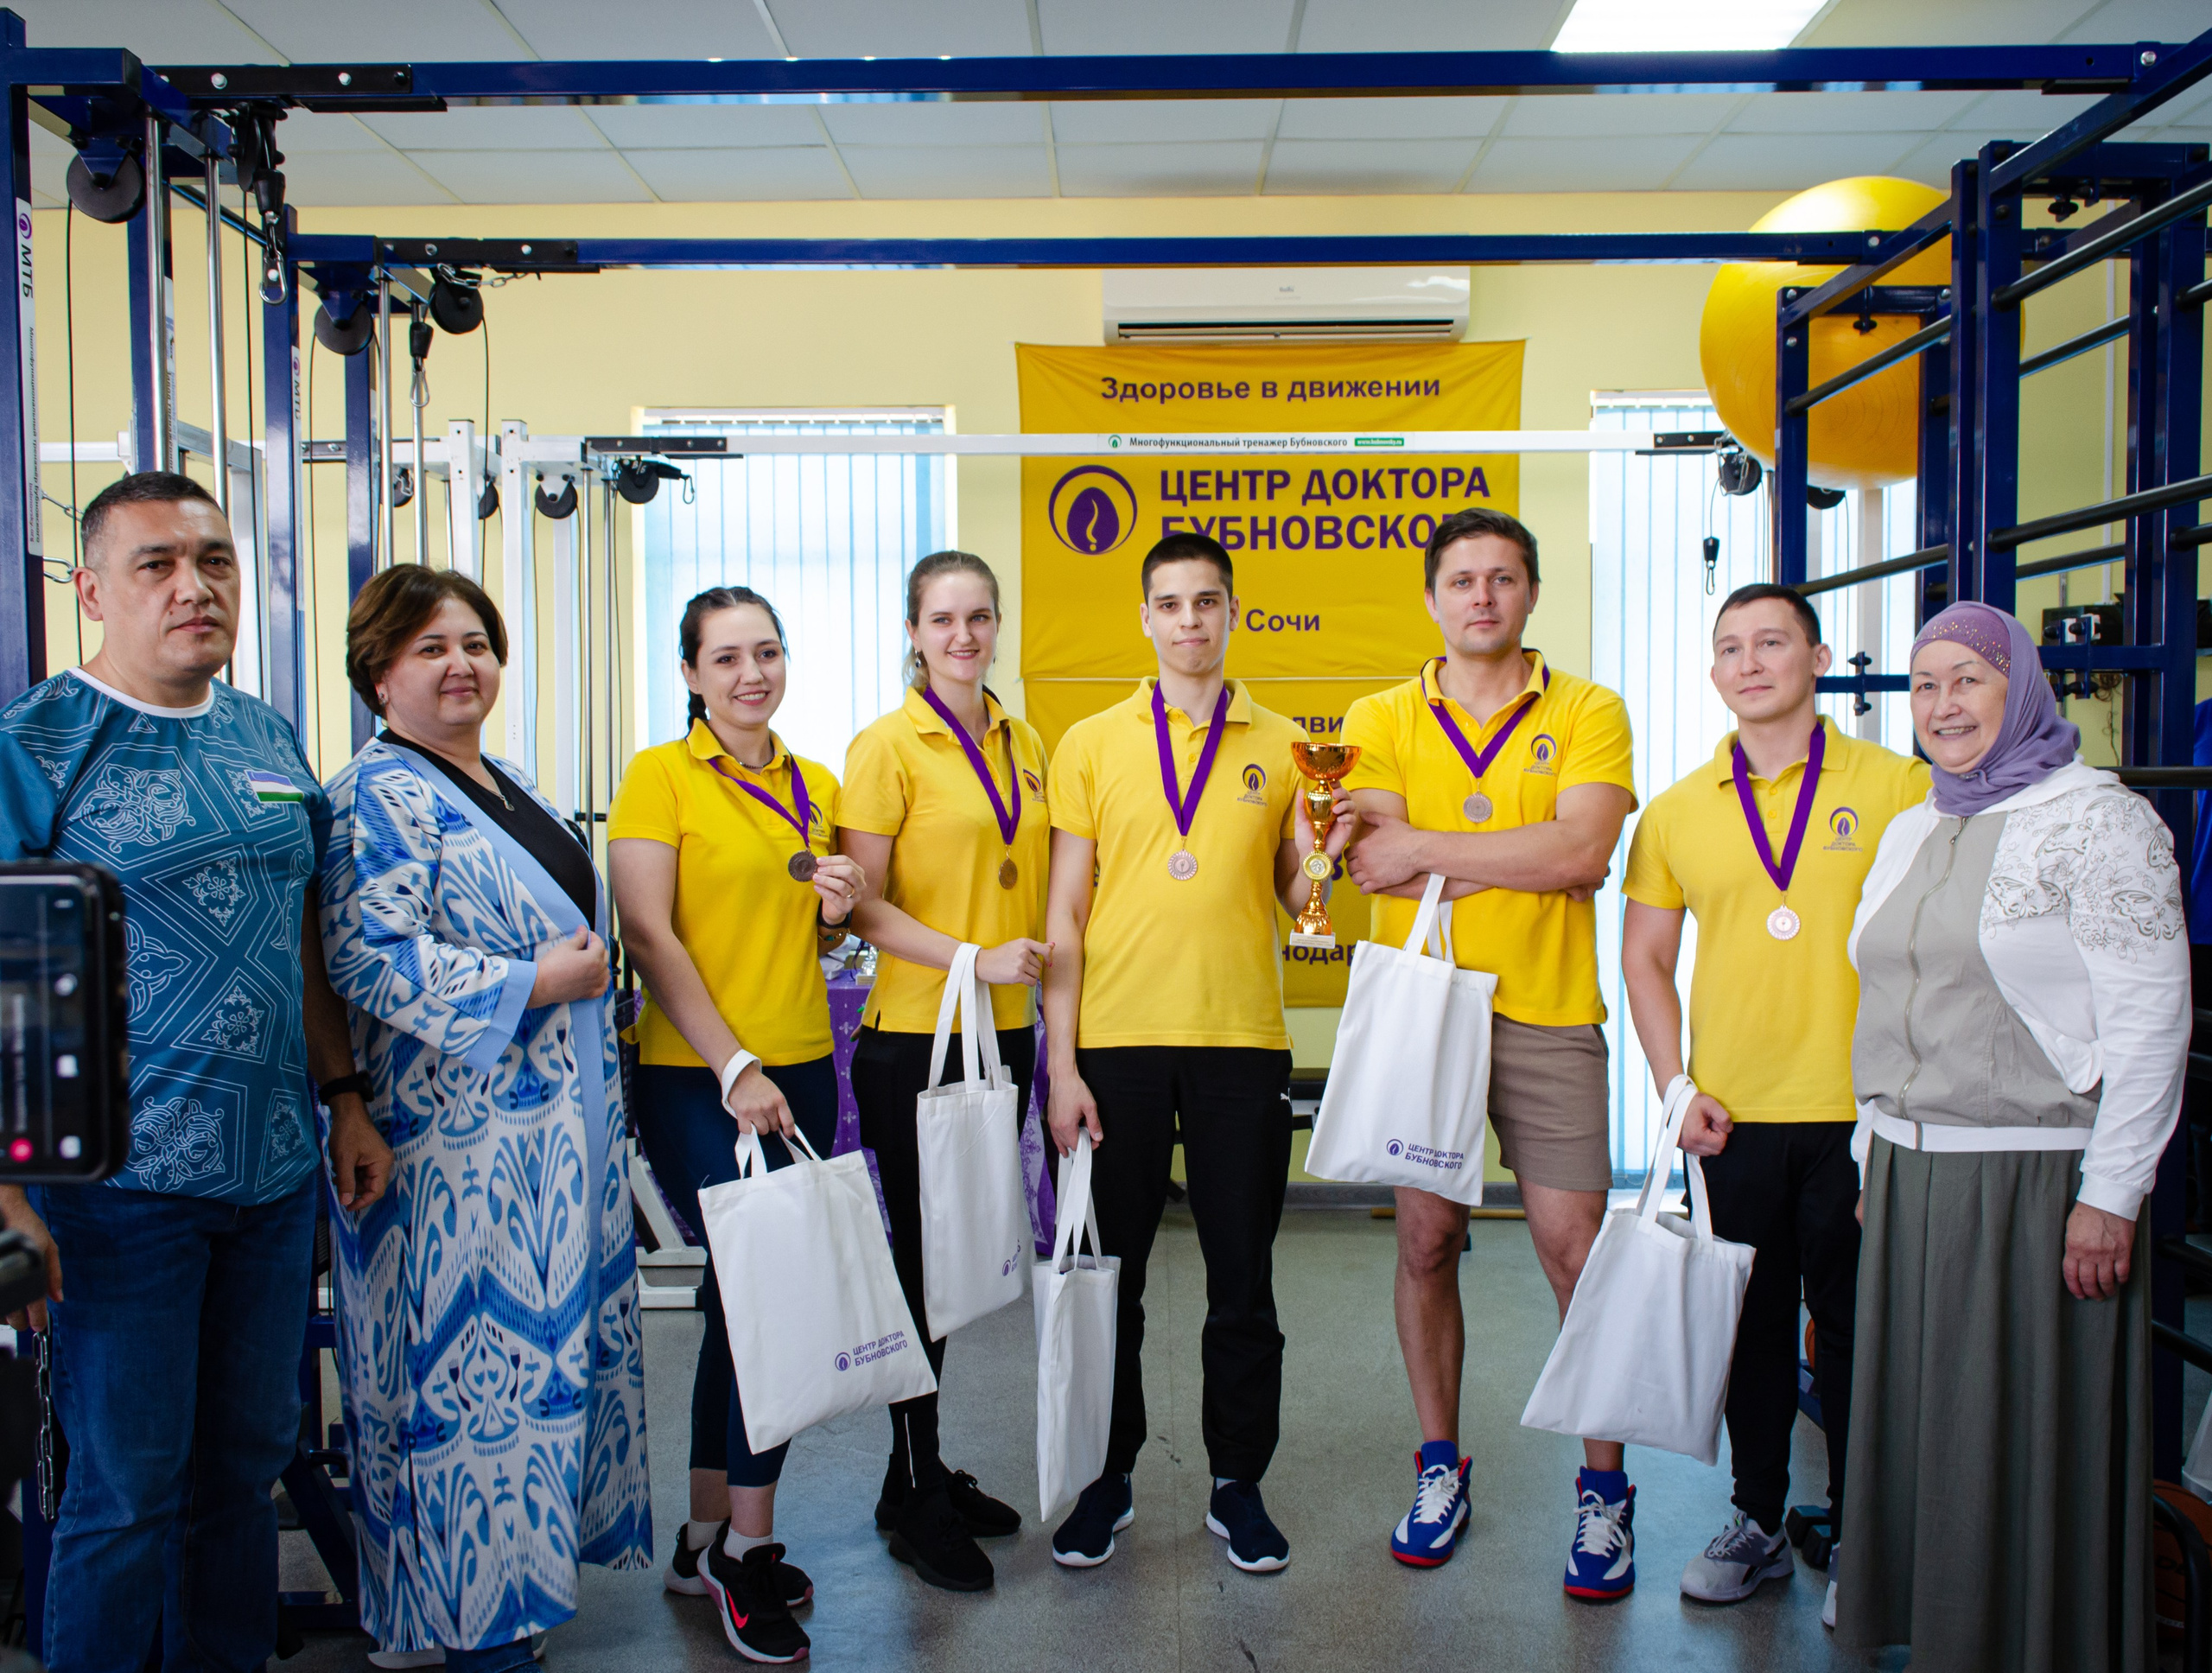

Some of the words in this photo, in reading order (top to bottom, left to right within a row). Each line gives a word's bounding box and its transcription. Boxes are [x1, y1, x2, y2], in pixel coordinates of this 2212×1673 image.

[20, 243, 34, 299] МТБ
[1101, 377, 1250, 404] Здоровье
[1262, 381, 1278, 399] в
[1287, 378, 1440, 403] движении
[1129, 437, 1240, 448] Многофункциональный
[1243, 439, 1287, 448] тренажер
[1290, 437, 1348, 448] Бубновского
[1160, 469, 1291, 507] ЦЕНТР
[1301, 467, 1491, 506] ДОКТОРА
[1246, 608, 1319, 632] Сочи
[1405, 1152, 1462, 1169] БУБНОВСКОГО
[1408, 1143, 1433, 1155] ЦЕНТР
[853, 1340, 876, 1356] ЦЕНТР
[878, 1331, 905, 1348] ДОКТОРА
[855, 1339, 907, 1366] БУБНОВСКОГО
